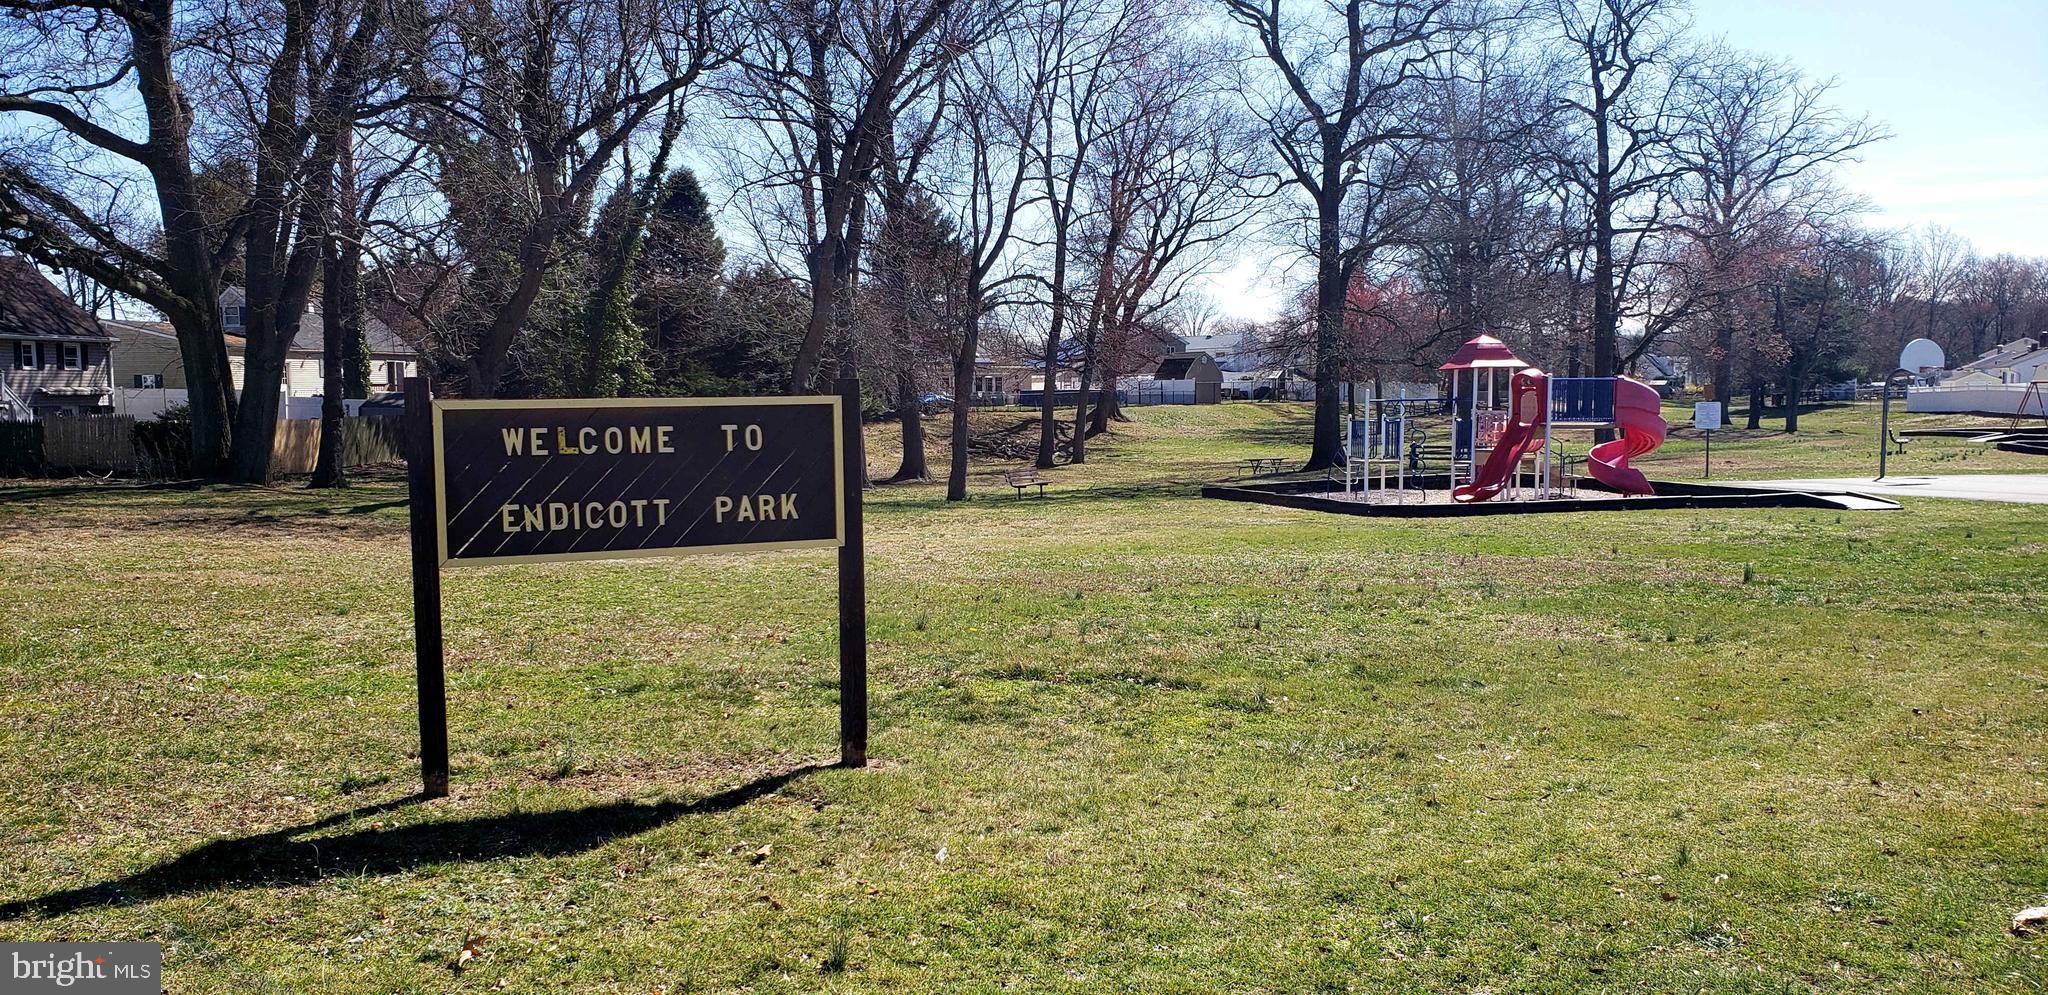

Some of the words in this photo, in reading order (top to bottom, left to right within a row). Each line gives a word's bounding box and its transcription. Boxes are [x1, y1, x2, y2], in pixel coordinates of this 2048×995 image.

[502, 425, 675, 456] WELCOME
[721, 424, 763, 451] TO
[502, 499, 671, 533] ENDICOTT
[715, 493, 799, 523] PARK
